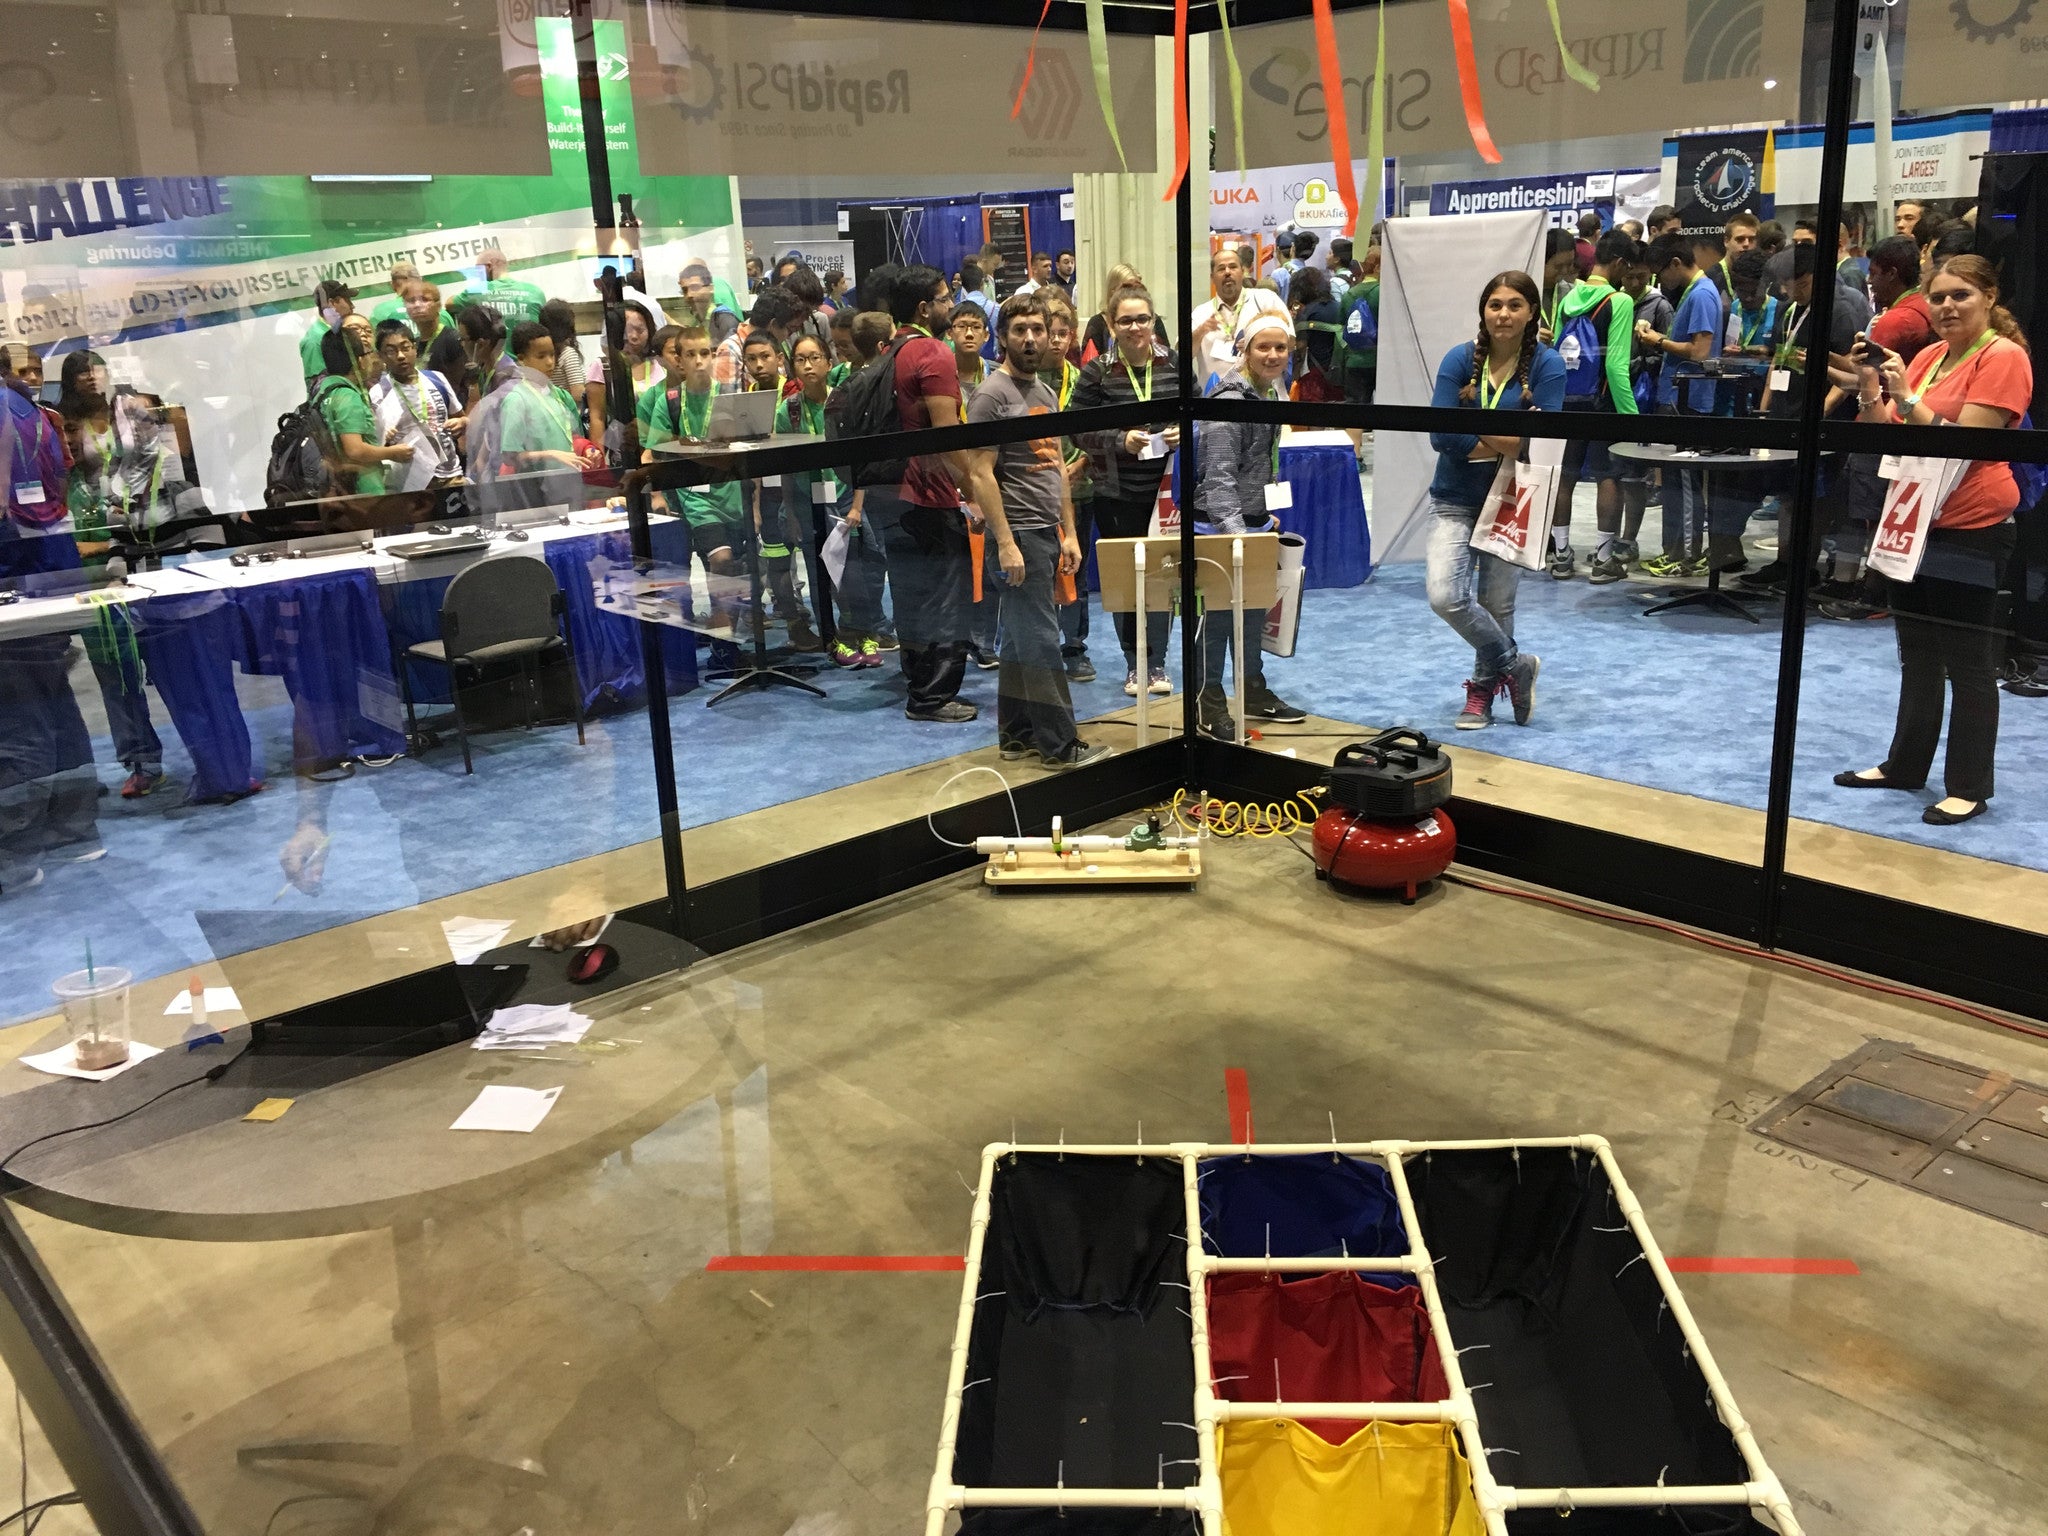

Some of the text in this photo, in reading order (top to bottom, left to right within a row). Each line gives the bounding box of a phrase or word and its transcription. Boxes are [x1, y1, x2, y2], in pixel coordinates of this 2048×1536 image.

[1696, 148, 1754, 171] team america
[1901, 159, 1940, 179] LARGEST
[1209, 187, 1260, 205] UKA
[1694, 179, 1720, 212] rocketry
[1679, 226, 1726, 235] ROCKETCON
[424, 236, 500, 264] SYSTEM
[805, 254, 844, 264] Project
